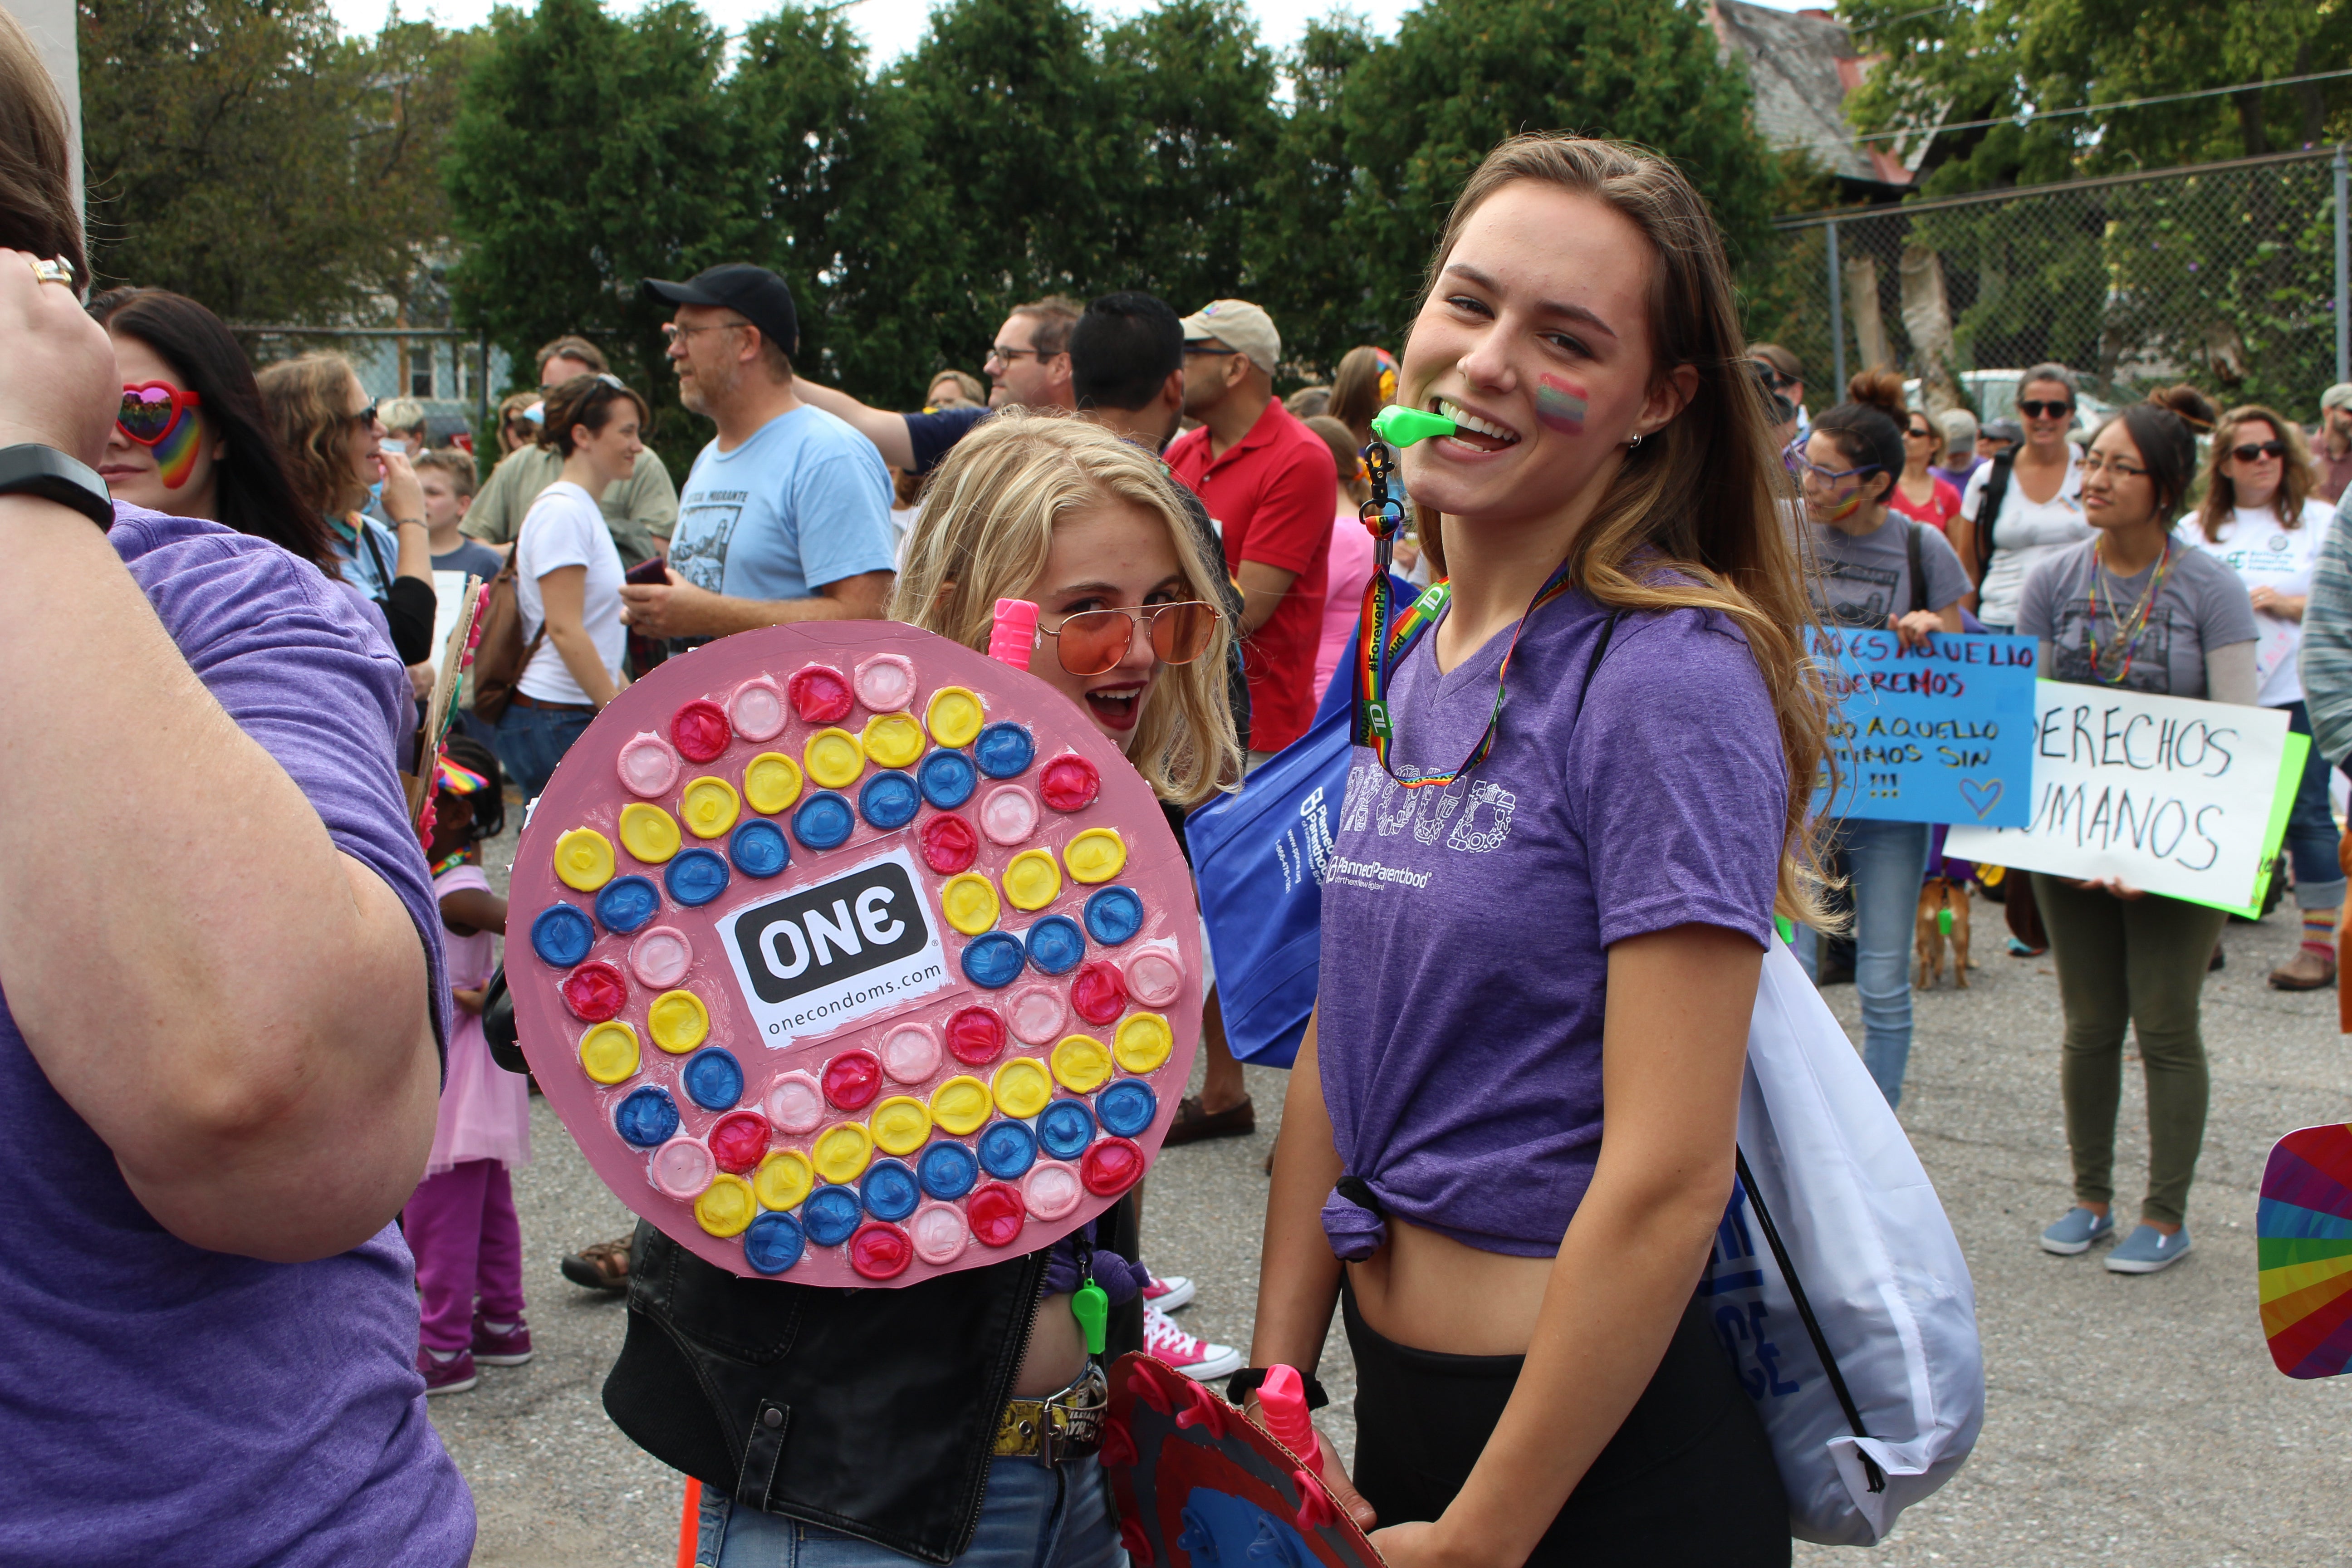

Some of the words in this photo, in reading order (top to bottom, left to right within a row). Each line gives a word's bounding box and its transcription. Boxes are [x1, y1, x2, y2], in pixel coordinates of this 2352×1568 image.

[1368, 573, 1386, 672] #ForeverPro
[1417, 586, 1444, 611] TD
[1369, 704, 1387, 733] TD
[1867, 716, 1999, 740] AQUELLO
[2034, 705, 2239, 777] ERECHOS
[1937, 745, 1991, 769] SIN
[1306, 811, 1328, 876] Parentho
[1987, 781, 2223, 871] UMANOS
[1337, 856, 1374, 878] Panned
[759, 886, 906, 979] ONE
[769, 965, 941, 1034] onecondoms.com
